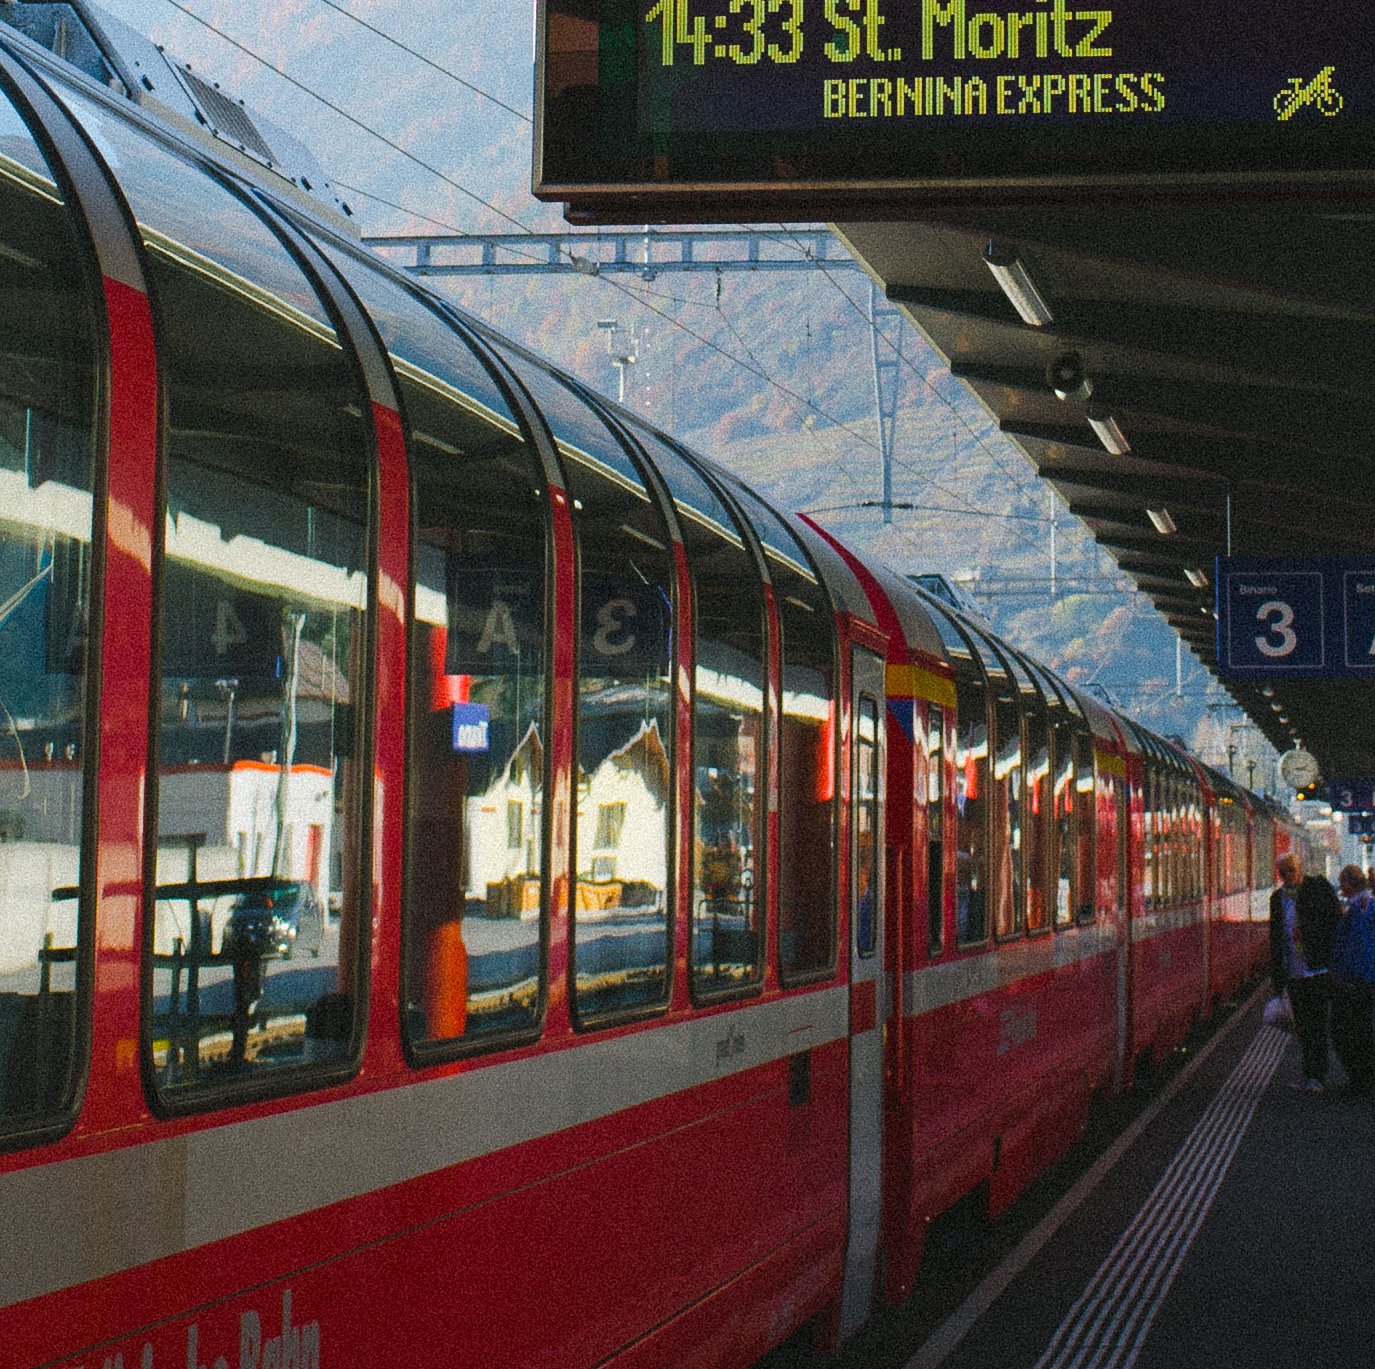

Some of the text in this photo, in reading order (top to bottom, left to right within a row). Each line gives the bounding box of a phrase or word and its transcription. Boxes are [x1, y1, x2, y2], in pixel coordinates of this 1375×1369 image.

[824, 73, 1166, 118] BERNINA EXPRESS
[1255, 600, 1297, 657] 3
[1341, 791, 1353, 807] 3
